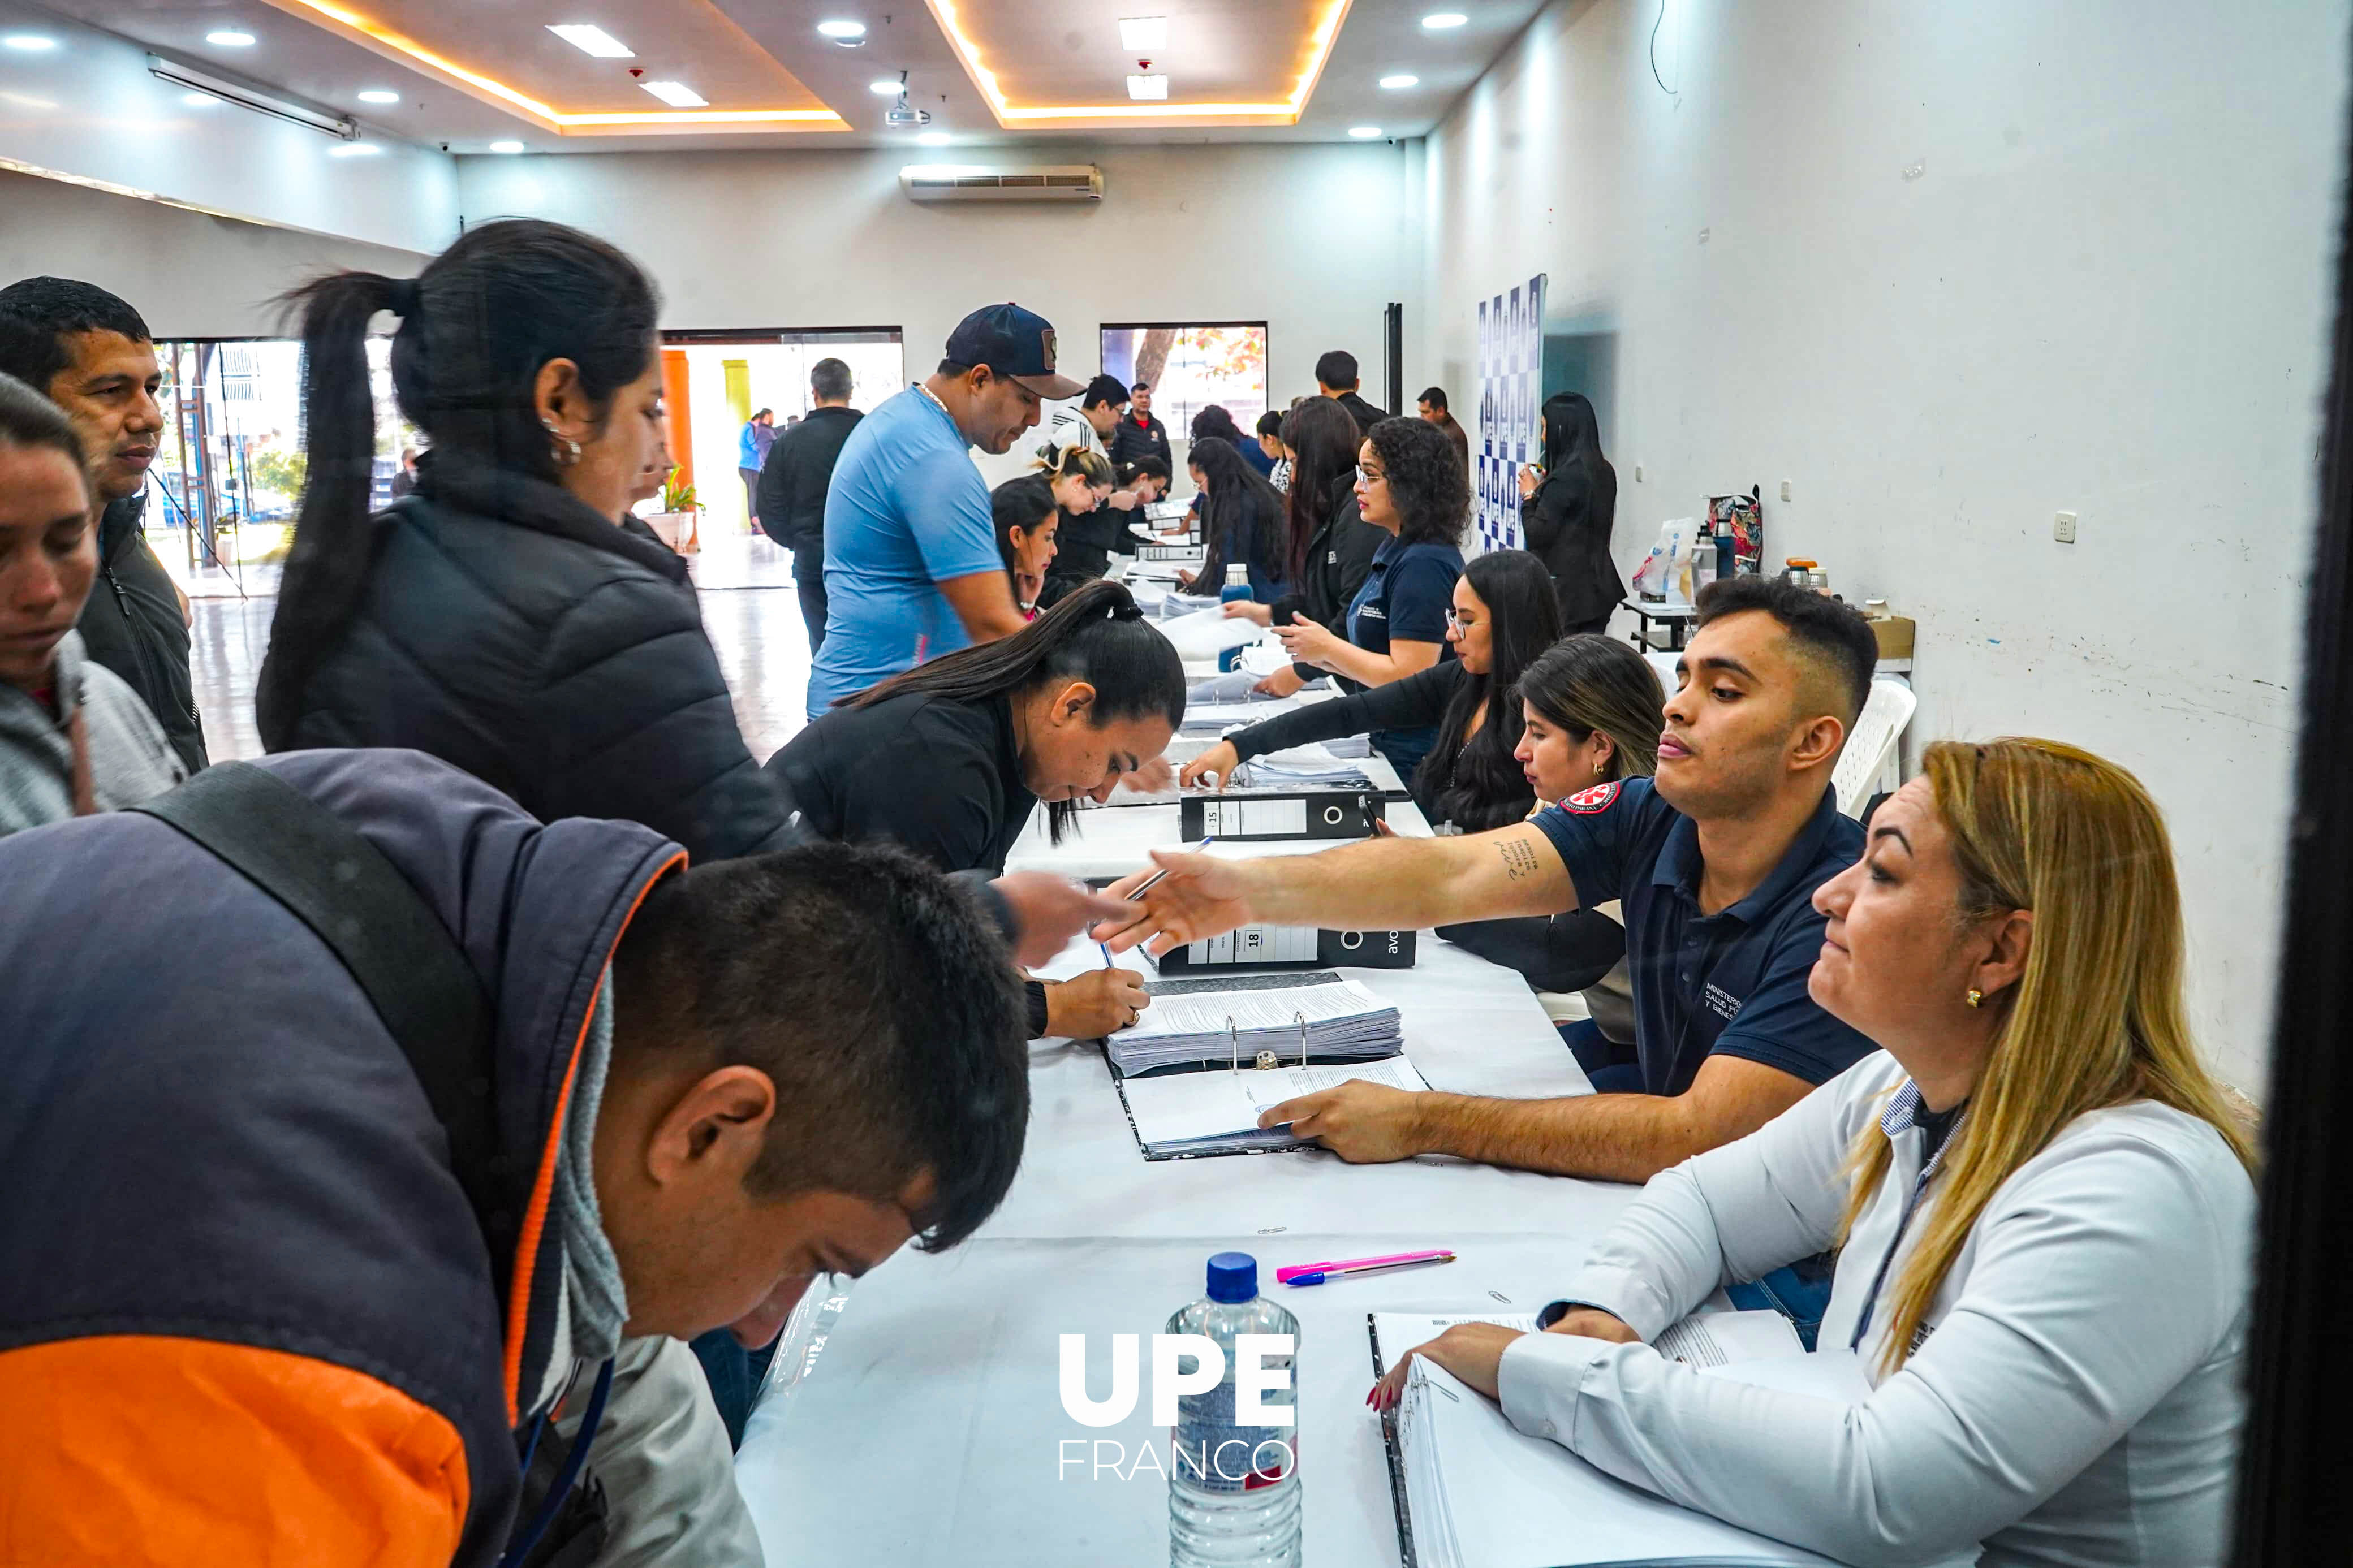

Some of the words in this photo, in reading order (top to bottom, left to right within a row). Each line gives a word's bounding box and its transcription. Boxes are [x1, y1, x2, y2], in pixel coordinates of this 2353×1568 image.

[1209, 812, 1217, 822] 15
[1249, 934, 1259, 947] 18
[1389, 930, 1399, 954] avo
[1706, 991, 1726, 1008] SALUD
[1713, 1004, 1734, 1021] BIENES
